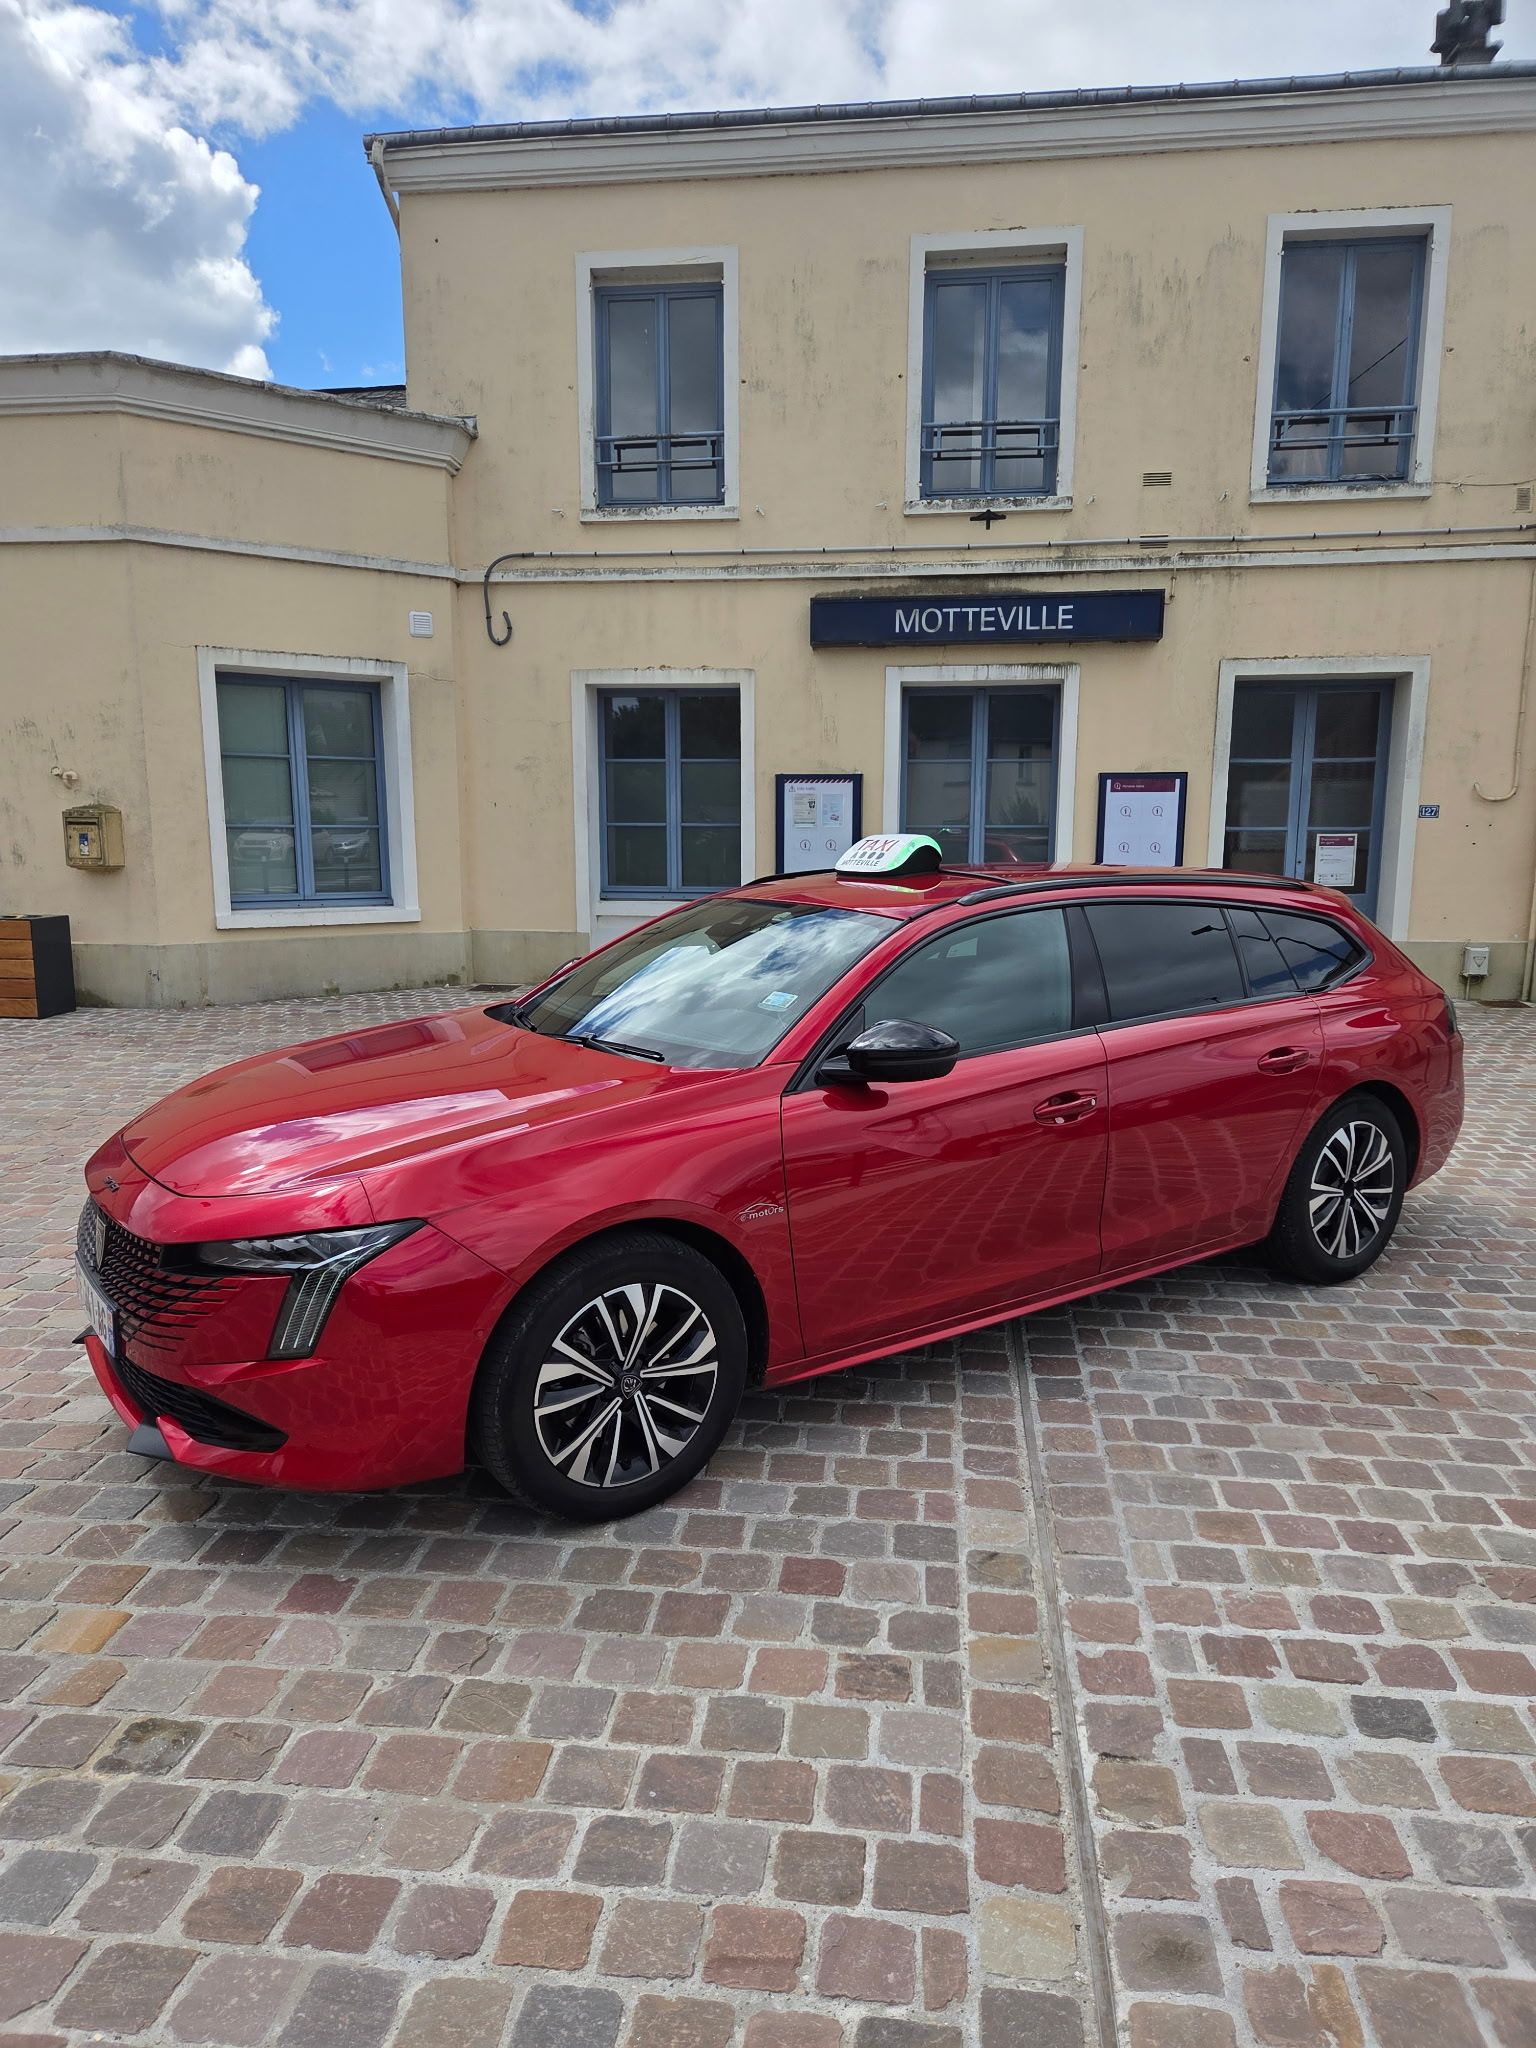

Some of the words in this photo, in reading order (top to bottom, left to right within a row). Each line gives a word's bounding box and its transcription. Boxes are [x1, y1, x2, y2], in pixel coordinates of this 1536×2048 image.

[895, 604, 1074, 633] MOTTEVILLE
[1421, 807, 1437, 816] 127
[858, 839, 900, 852] TAXI
